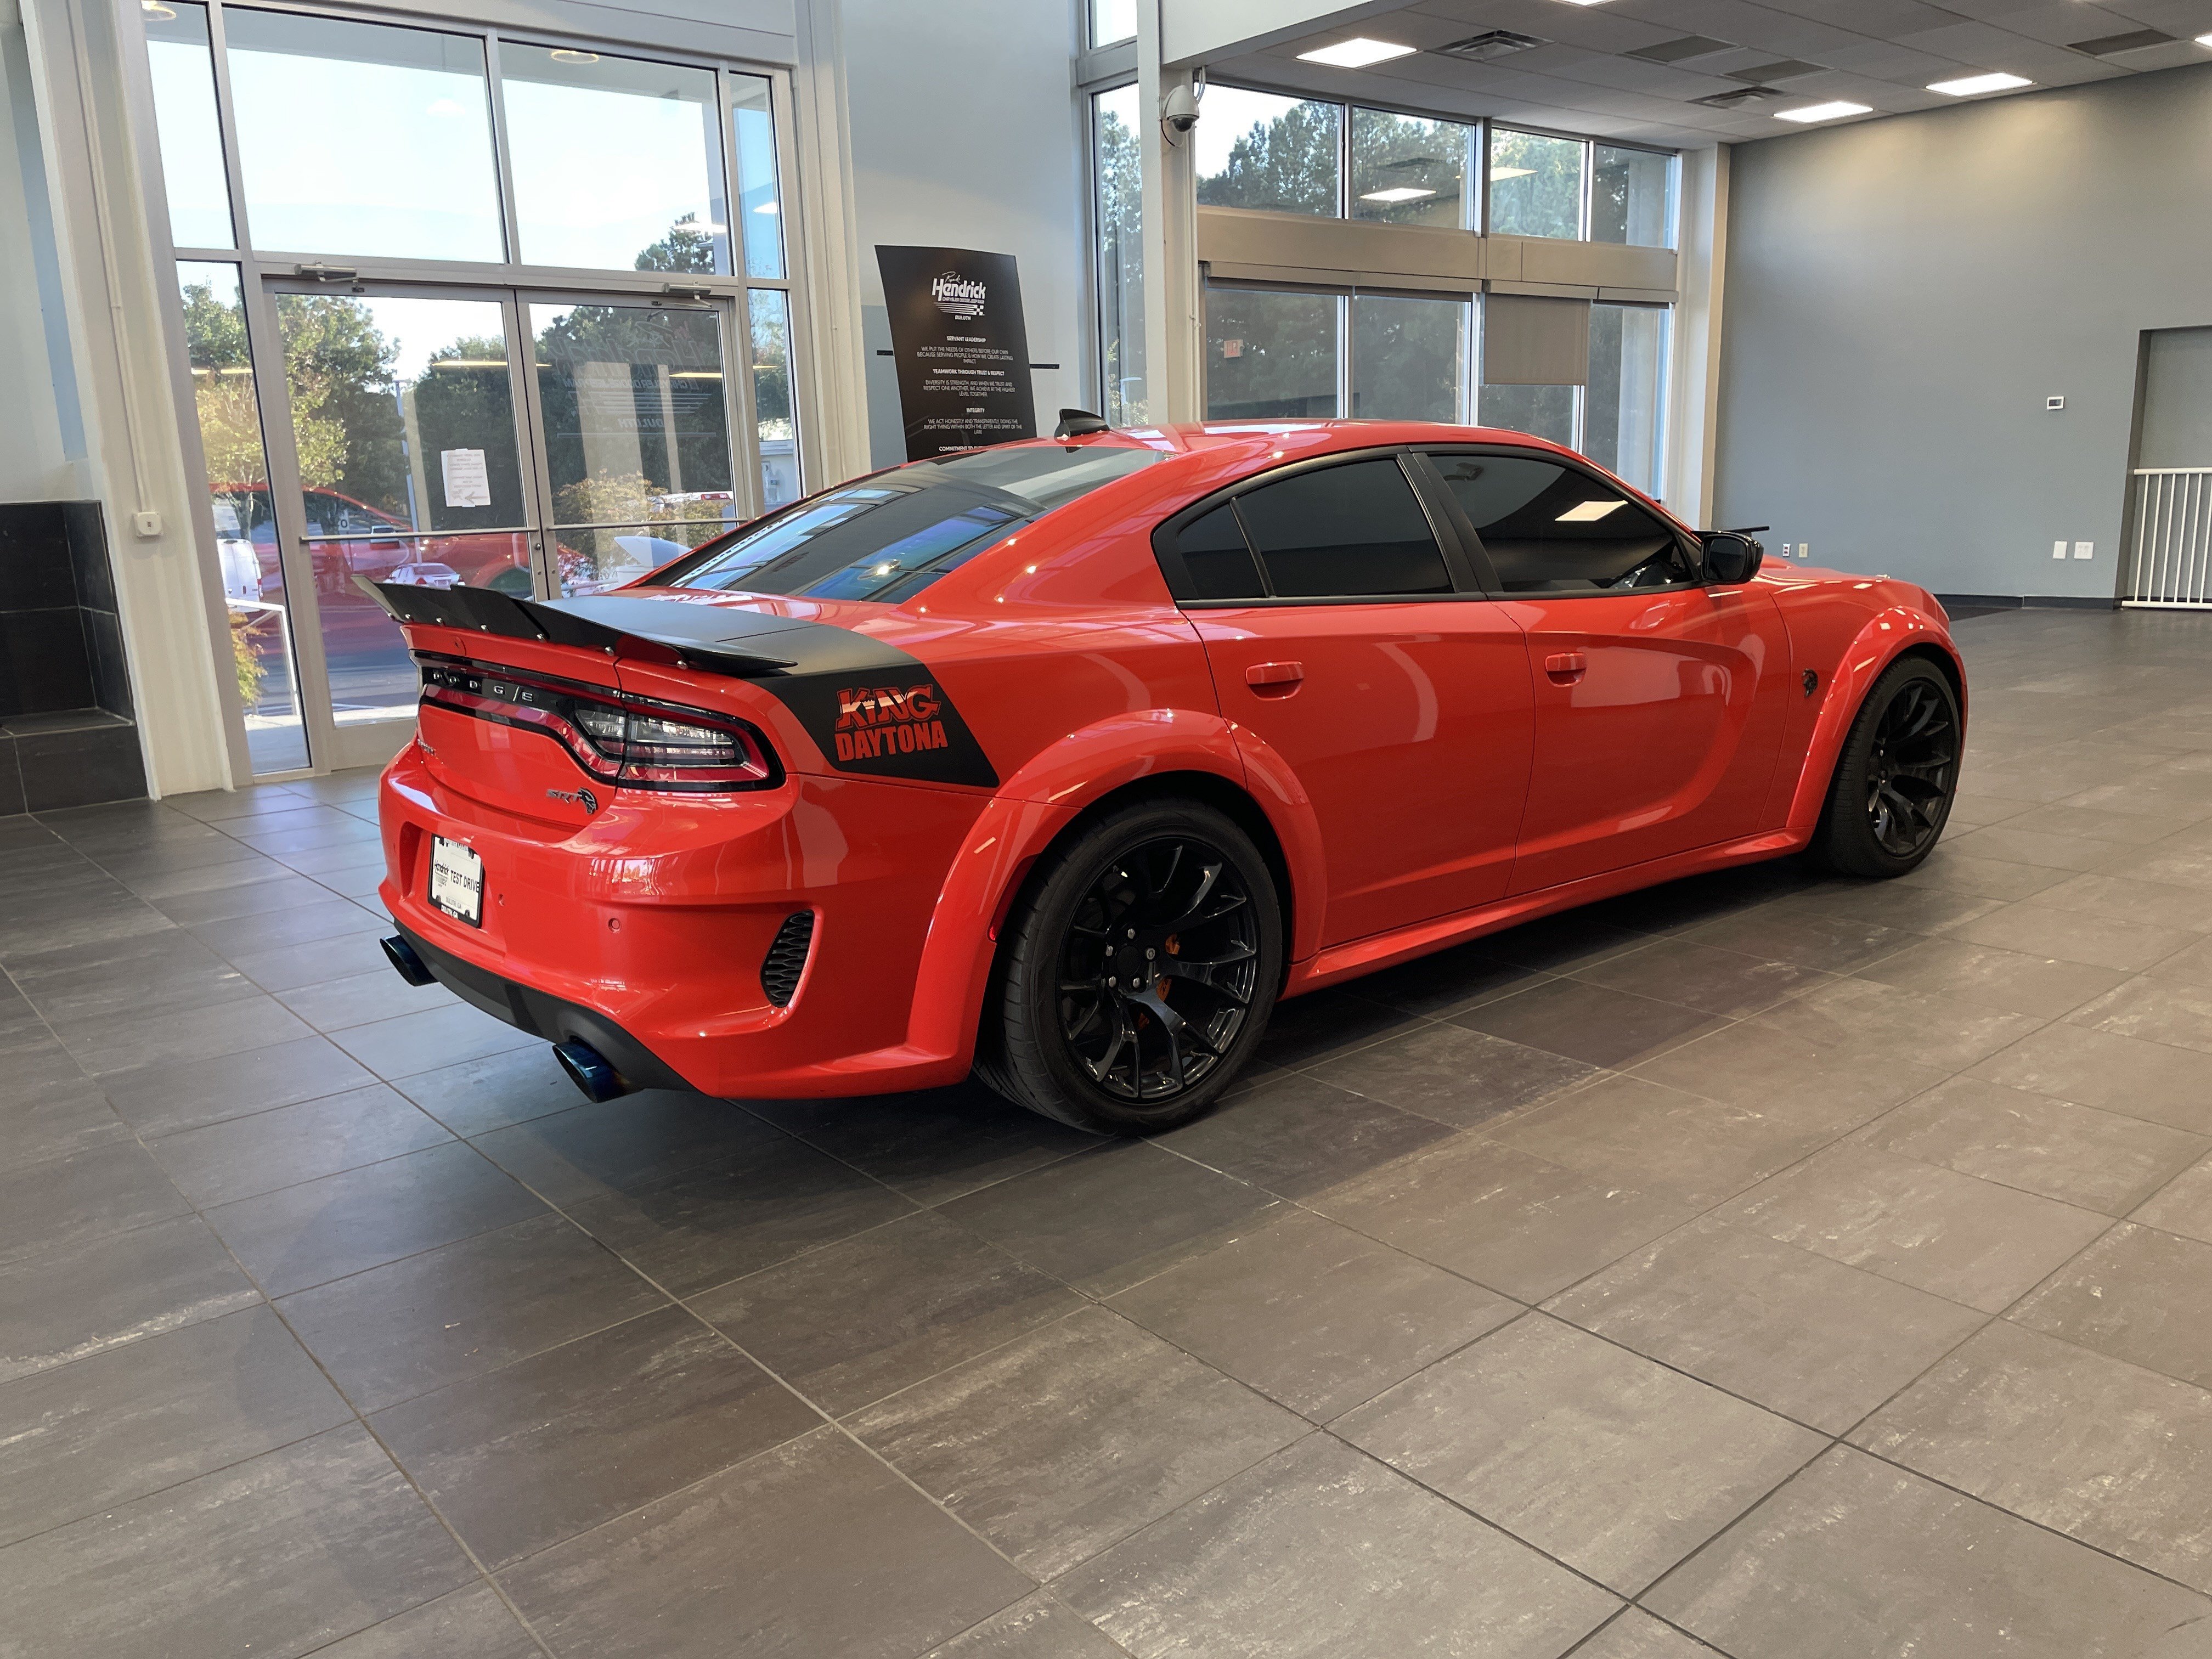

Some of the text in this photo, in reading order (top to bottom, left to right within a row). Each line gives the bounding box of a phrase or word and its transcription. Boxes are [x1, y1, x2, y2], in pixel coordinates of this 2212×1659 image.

[932, 278, 986, 302] Hendrick
[834, 720, 949, 762] DAYTONA
[450, 869, 462, 887] TEST
[463, 875, 480, 894] DRIVE
